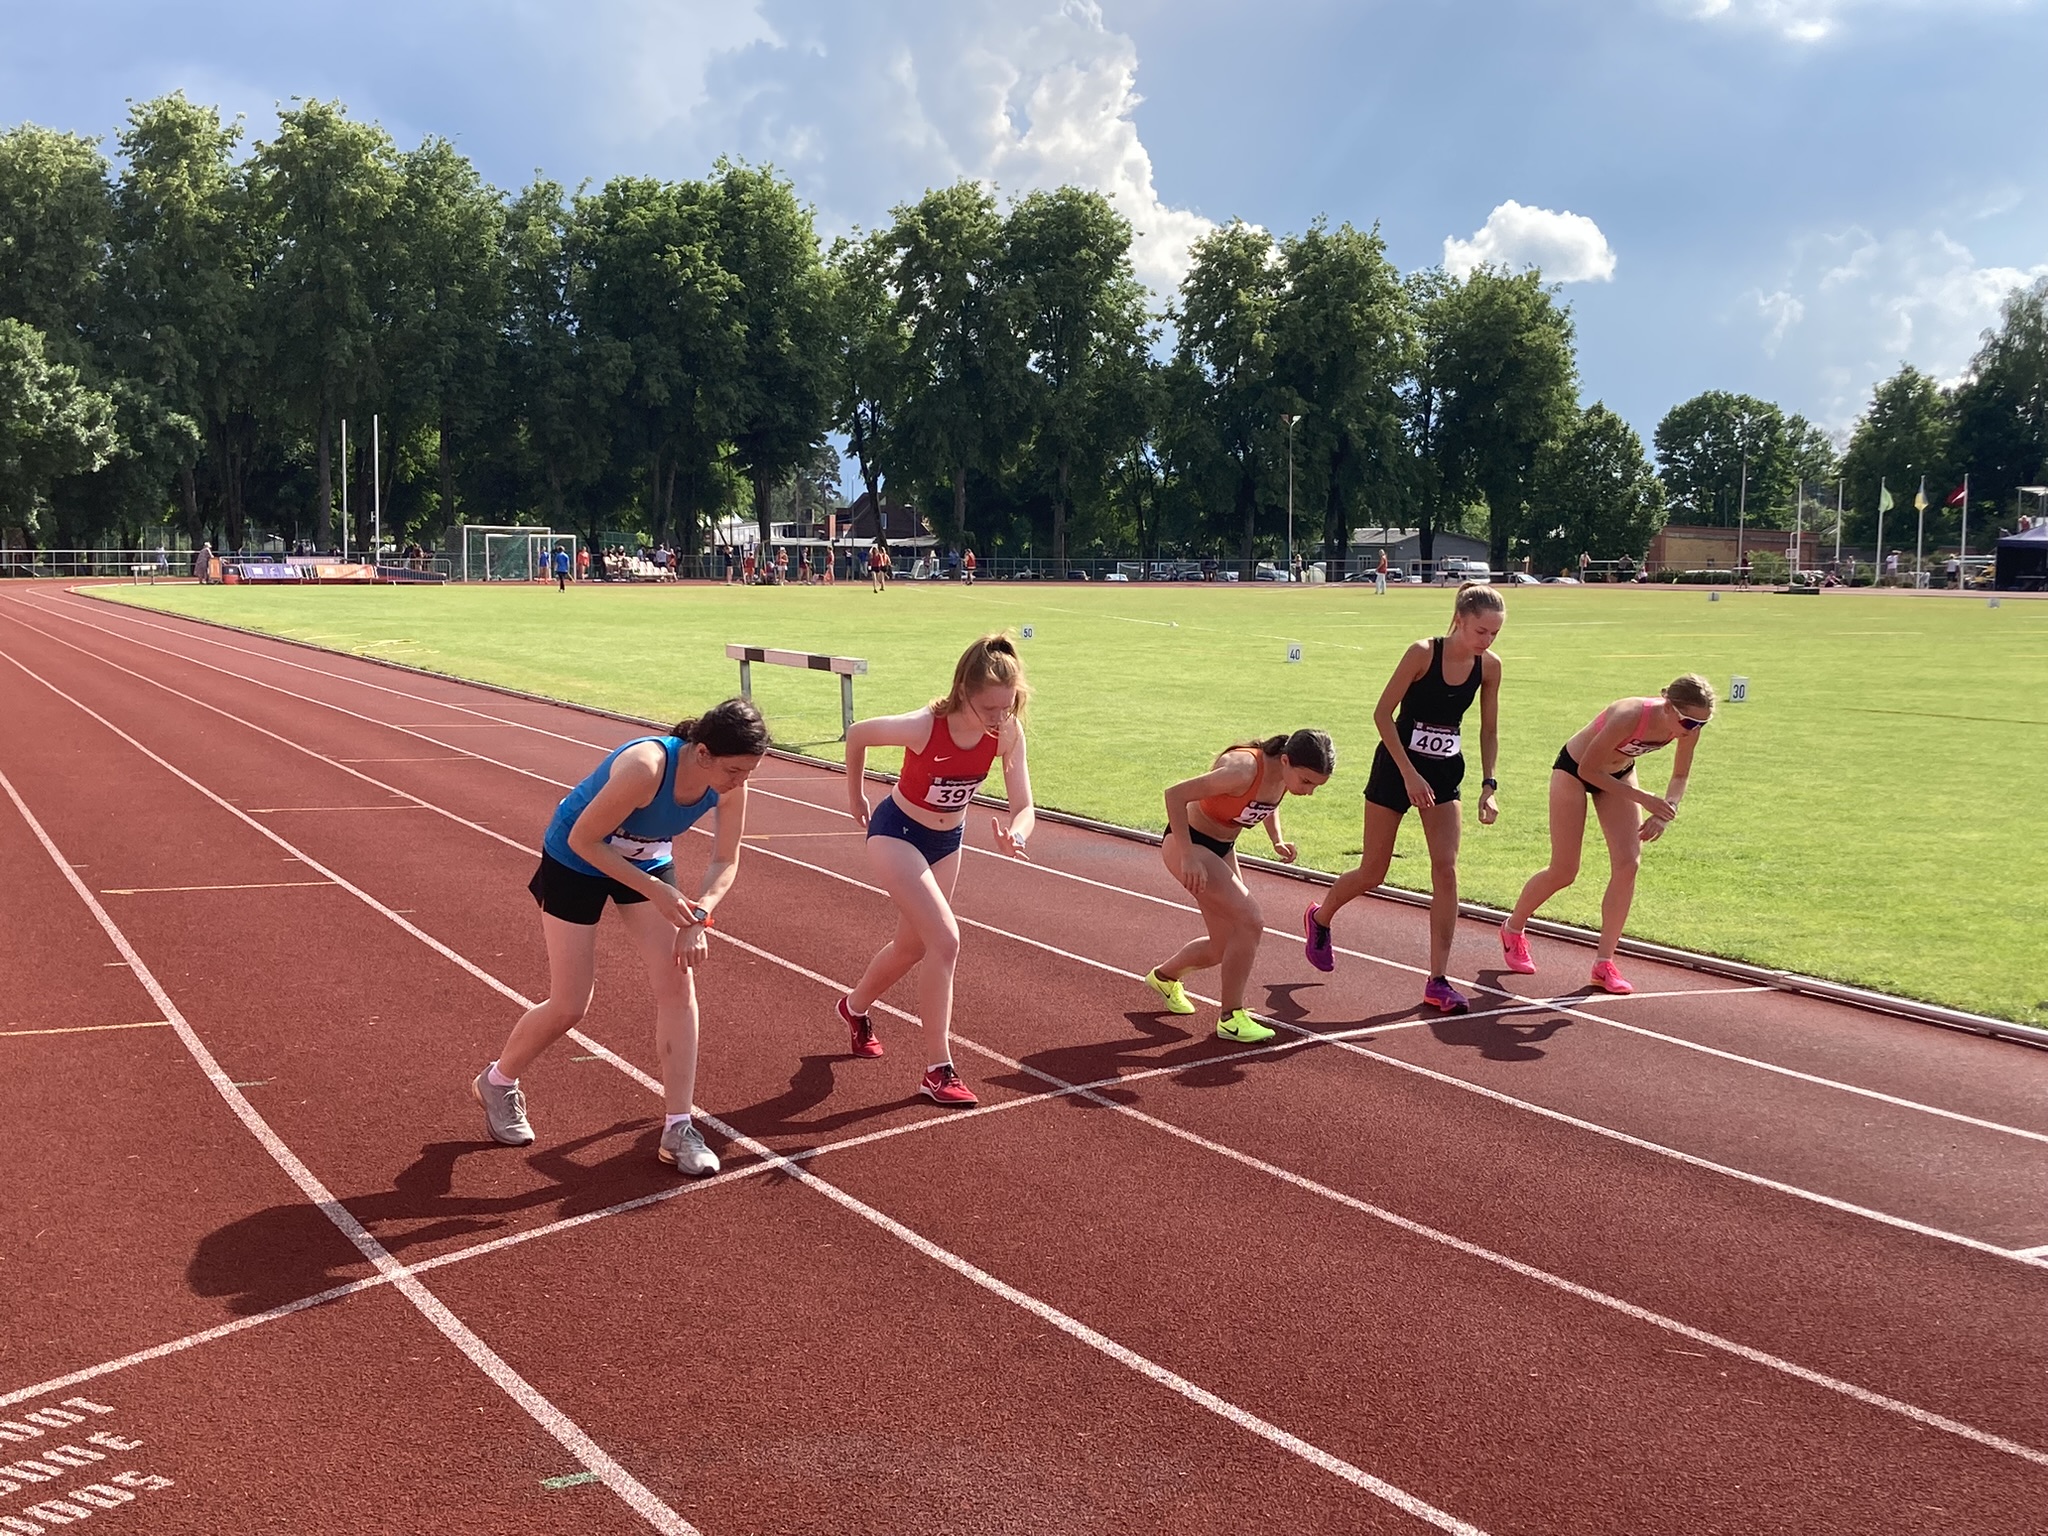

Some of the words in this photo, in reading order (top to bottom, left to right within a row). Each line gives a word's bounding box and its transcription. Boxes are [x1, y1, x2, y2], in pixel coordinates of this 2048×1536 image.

[1023, 628, 1033, 638] 50
[1290, 648, 1301, 660] 40
[1732, 684, 1746, 699] 30
[1416, 735, 1455, 753] 402
[936, 787, 976, 804] 391
